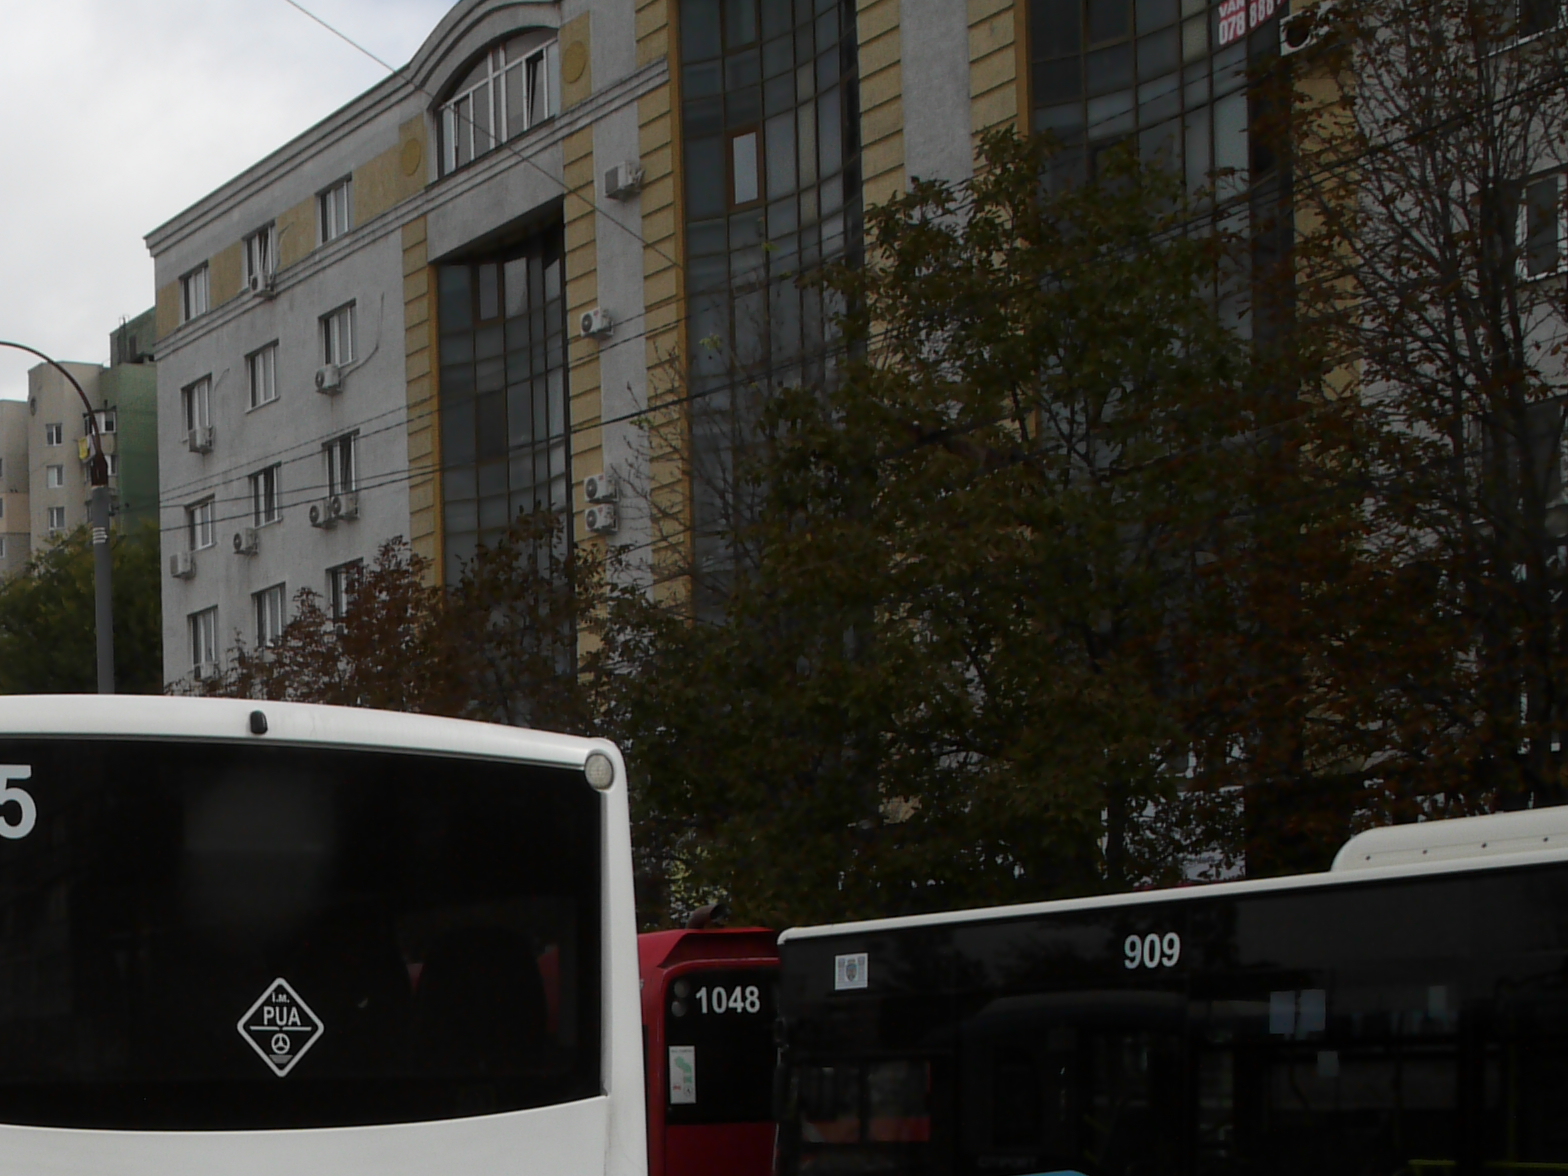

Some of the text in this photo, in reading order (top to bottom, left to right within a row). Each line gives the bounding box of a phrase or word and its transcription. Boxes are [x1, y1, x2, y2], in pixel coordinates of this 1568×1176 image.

[1219, 11, 1246, 45] 078
[1124, 932, 1180, 969] 909
[696, 985, 760, 1014] 1048
[263, 1006, 301, 1026] PUA
